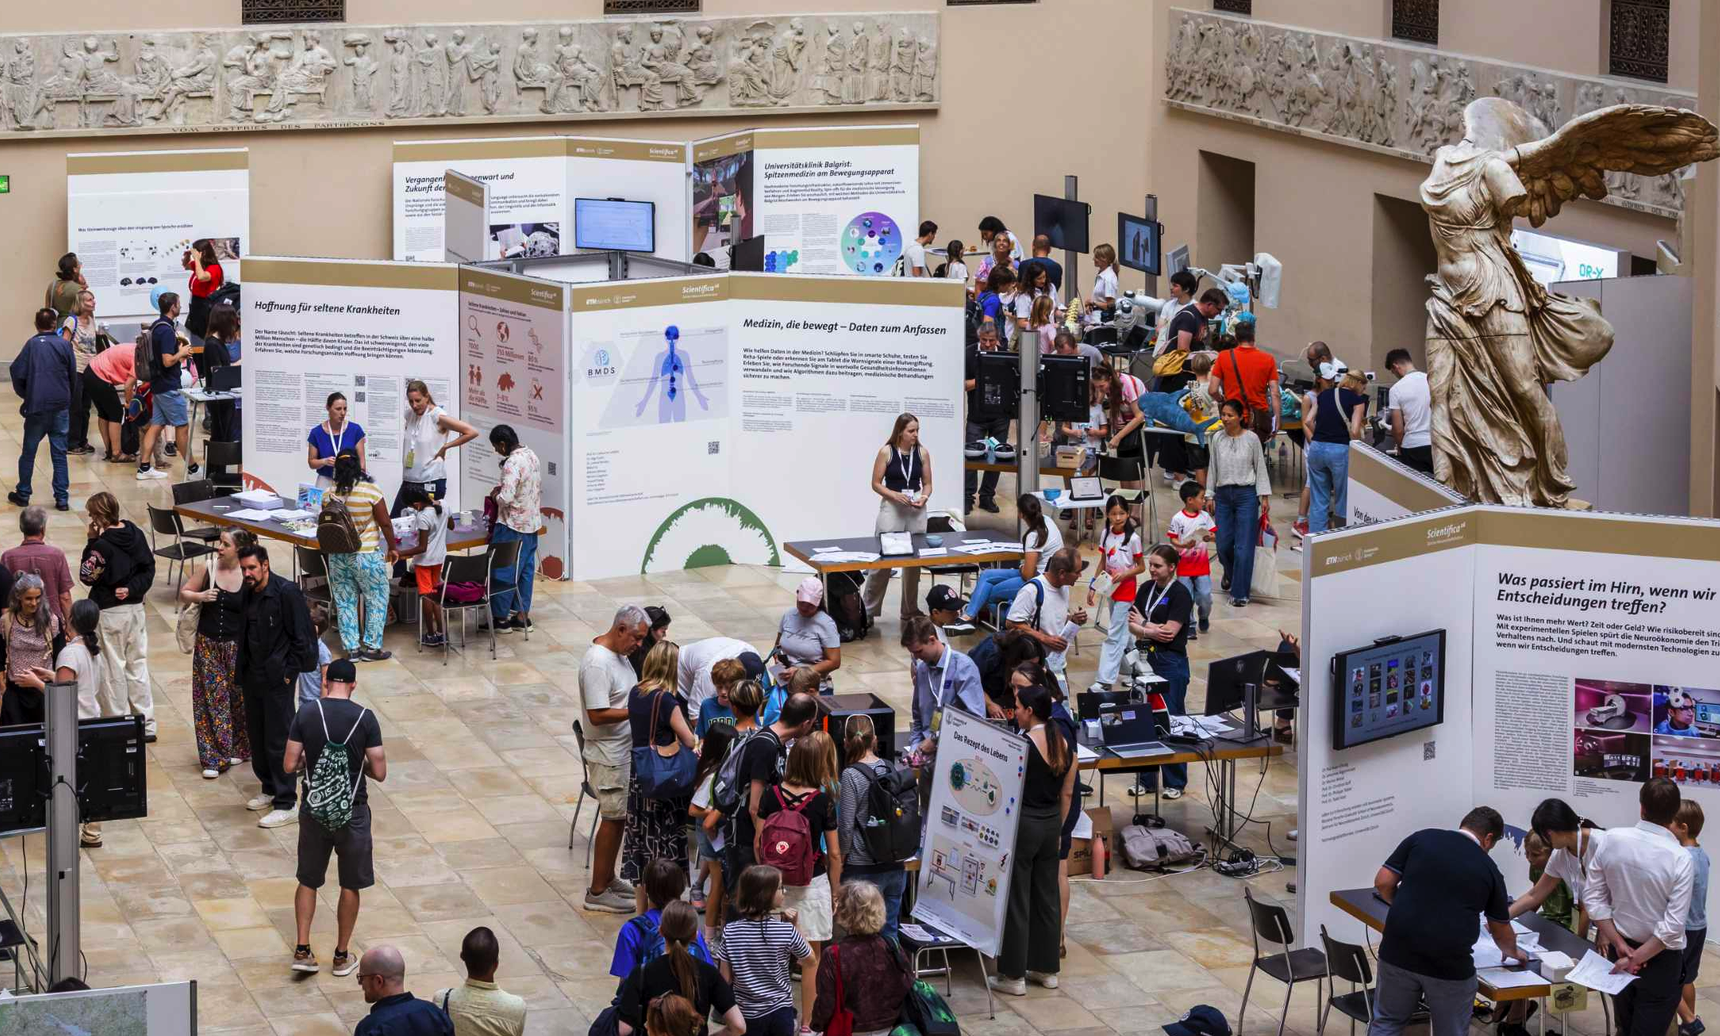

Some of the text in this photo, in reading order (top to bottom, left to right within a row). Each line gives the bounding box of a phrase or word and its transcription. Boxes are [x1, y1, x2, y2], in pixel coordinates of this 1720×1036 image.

[764, 160, 852, 170] Universitätsklinik Balgrist:
[500, 172, 514, 180] und
[764, 170, 816, 180] Spitzenmedizin
[829, 168, 894, 178] Bewegungsapparat
[405, 184, 433, 193] Zukunft
[682, 285, 714, 294] Scientifica
[255, 301, 400, 315] Hoffnung für seltene Krankheiten
[743, 319, 784, 331] Medizin,
[786, 320, 800, 329] die
[802, 321, 838, 333] bewegt
[849, 323, 878, 332] Daten
[903, 325, 946, 336] Anfassen
[587, 366, 615, 376] BMDS
[1354, 506, 1363, 519] Von
[1426, 525, 1461, 538] Scientifica
[1498, 572, 1717, 600] Was passiert im Hirn, wenn wir
[1497, 589, 1666, 616] Entscheidungen treffen?
[1524, 616, 1545, 624] Ihnen
[1567, 619, 1588, 628] Wert?
[1624, 624, 1645, 632] Geld?
[1663, 627, 1705, 637] risikobereit
[1510, 625, 1570, 635] experimentellen
[1571, 628, 1598, 637] Spielen
[1600, 631, 1619, 640] spürt
[1634, 633, 1693, 644] Neuroökonomie
[1496, 632, 1535, 641] Verhaltens
[1614, 642, 1659, 651] modernsten
[1660, 645, 1709, 656] Technologien
[1532, 643, 1589, 656] Entscheidungen
[1590, 648, 1617, 657] treffen.
[954, 731, 963, 742] Das
[964, 736, 980, 751] Rezept
[981, 743, 989, 753] des
[990, 748, 1008, 762] Lebens
